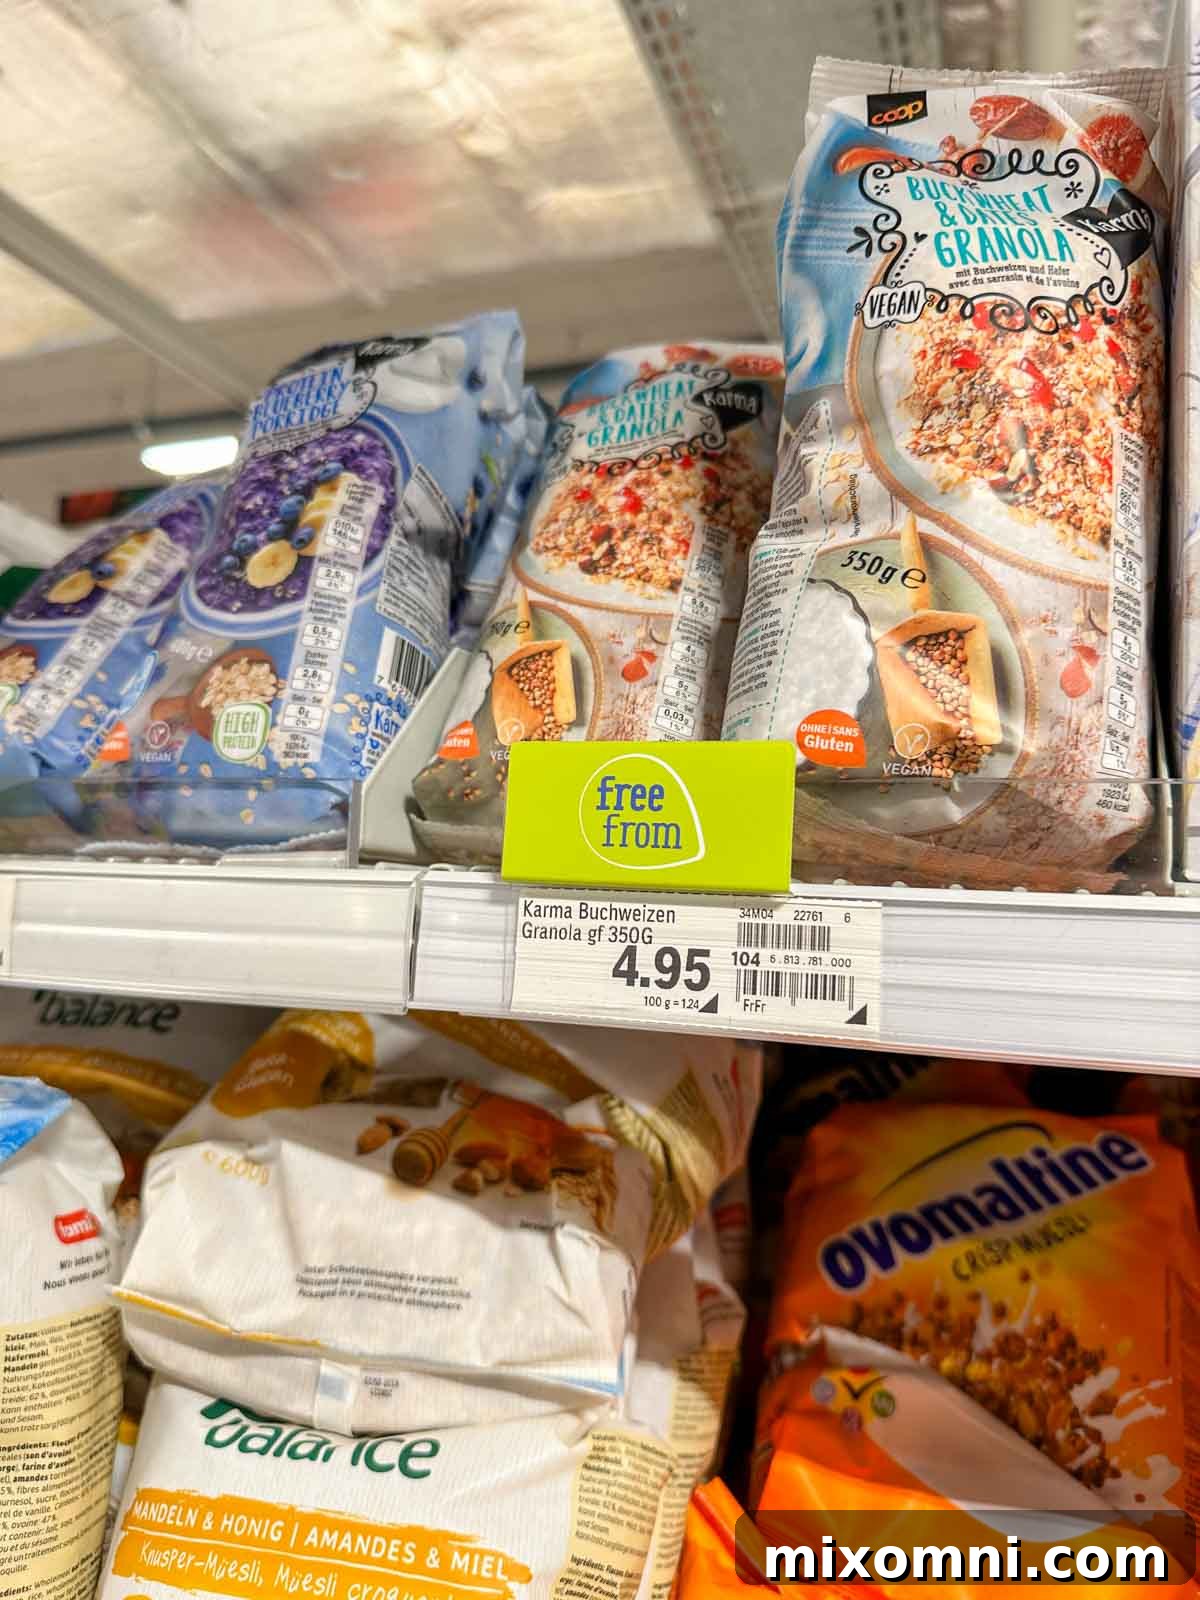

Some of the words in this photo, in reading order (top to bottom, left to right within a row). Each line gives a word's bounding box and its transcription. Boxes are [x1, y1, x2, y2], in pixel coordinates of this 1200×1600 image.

[870, 101, 924, 126] coop
[906, 175, 1053, 214] BUCKWHEAT
[935, 201, 956, 227] &
[958, 203, 1038, 227] DATES
[933, 226, 1076, 268] GRANOLA
[955, 268, 972, 279] mit
[973, 263, 1028, 276] Buchweizen
[948, 280, 970, 290] avec
[972, 277, 984, 287] du
[986, 273, 1024, 284] sarrasin
[1035, 275, 1045, 286] de
[869, 288, 920, 317] VEGAN
[703, 391, 757, 411] Karma
[587, 410, 685, 448] GRANOLA
[223, 711, 260, 734] HIGH
[803, 734, 855, 753] Gluten
[139, 750, 172, 763] VEGAN
[490, 750, 511, 761] VEG
[882, 762, 932, 777] VEGAN
[595, 776, 665, 812] free
[601, 813, 682, 850] from
[523, 899, 573, 919] Karma
[578, 902, 676, 924] Buchweizen
[739, 907, 774, 920] 34M04
[793, 909, 823, 922] 22761
[844, 912, 851, 923] 6
[521, 921, 582, 941] Granola
[587, 925, 605, 946] gf
[607, 925, 653, 945] 350G
[731, 951, 761, 967] 104
[611, 944, 711, 992] 4.95
[643, 995, 662, 1007] 100
[664, 999, 671, 1010] g
[743, 999, 767, 1014] FrFr
[822, 1133, 1151, 1292] ovomaltine
[951, 1237, 1013, 1282] CRISP
[43, 1278, 66, 1291] Nous
[5, 1331, 40, 1342] Zutaten:
[4, 1350, 49, 1363] Hafermehl
[3, 1362, 38, 1374] Mandeln
[0, 1416, 16, 1425] und
[0, 1440, 49, 1453] ngrédients:
[22, 1460, 45, 1471] farine
[13, 1474, 49, 1483] amandes
[16, 1484, 40, 1494] fibres
[12, 1508, 24, 1517] de
[8, 1528, 44, 1541] contenir:
[132, 1499, 199, 1528] MANDELN
[202, 1509, 214, 1531] &
[219, 1511, 284, 1542] HONIG
[304, 1526, 417, 1565] AMANDES
[426, 1546, 440, 1570] &
[450, 1548, 509, 1583] MIEL
[9, 1543, 19, 1552] et
[19, 1542, 31, 1551] du
[13, 1553, 23, 1562] un
[570, 1552, 605, 1571] Ingrédients:
[138, 1538, 265, 1588] Knusper-Müesli,
[272, 1566, 338, 1600] Müesli
[347, 1581, 455, 1600] croqu
